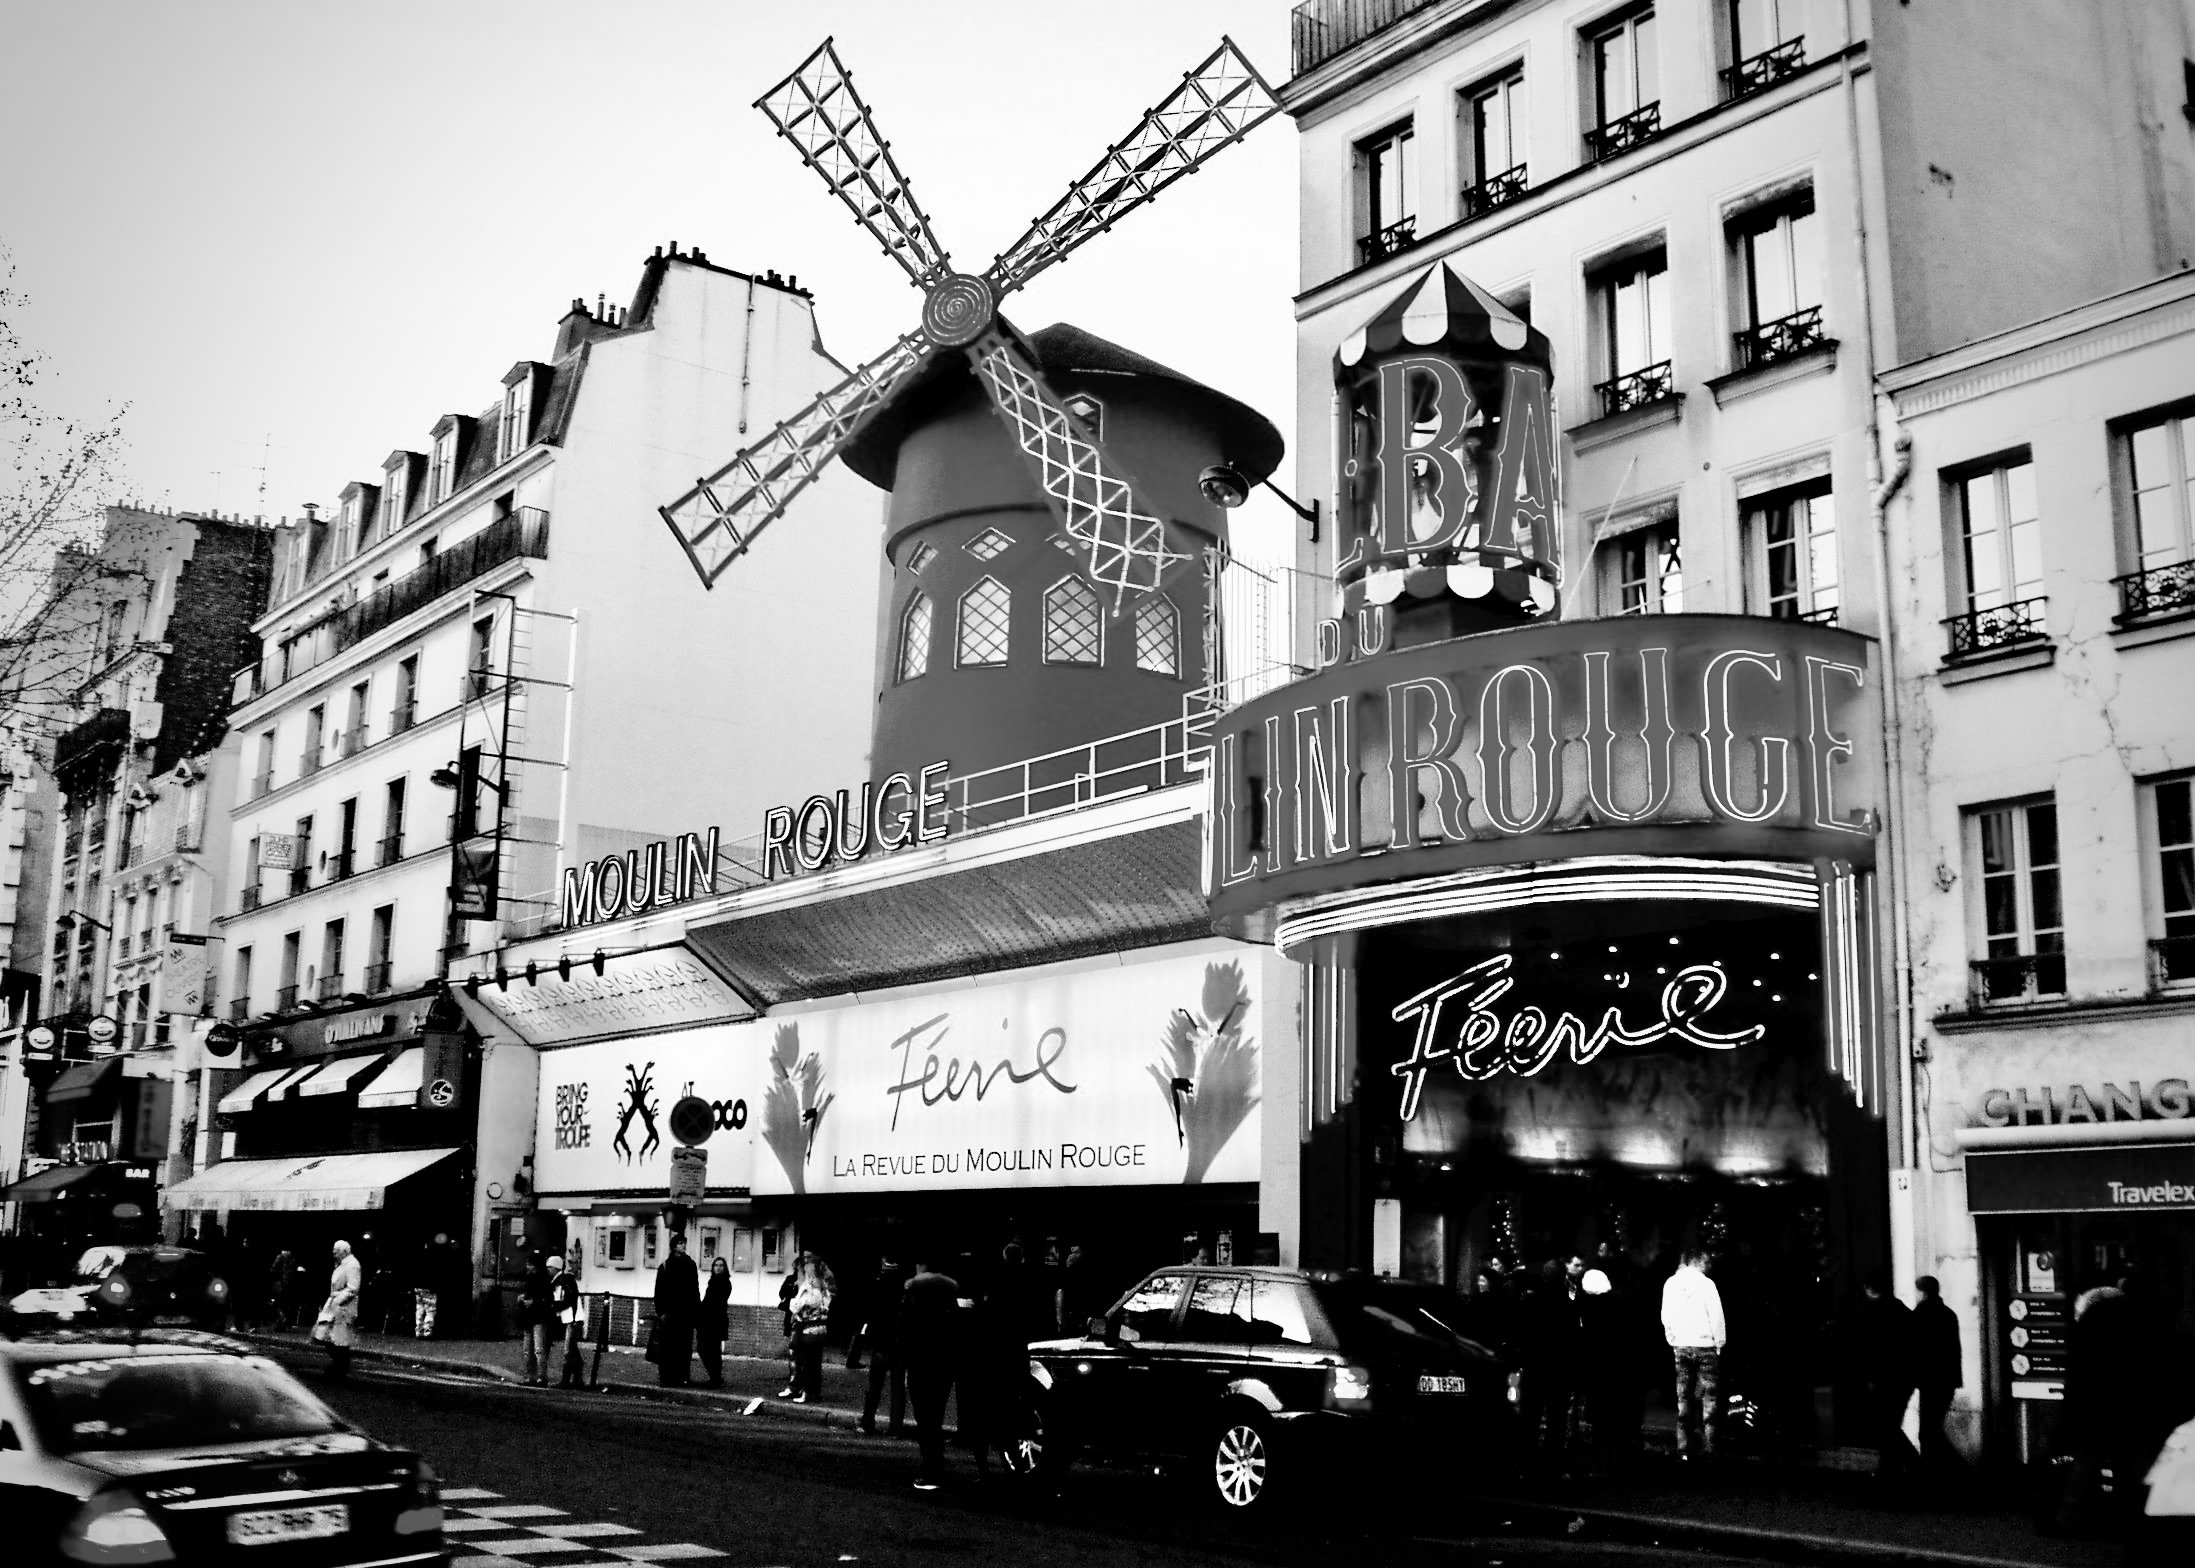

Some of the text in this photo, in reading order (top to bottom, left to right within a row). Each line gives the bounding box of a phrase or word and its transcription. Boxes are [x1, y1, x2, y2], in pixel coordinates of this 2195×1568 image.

[1318, 605, 1384, 667] DU
[1386, 647, 1872, 850] ROUGE
[562, 760, 950, 929] MOULIN ROUGE
[1391, 953, 1765, 1121] Féerie
[887, 1012, 1078, 1132] Féerie
[556, 1082, 588, 1106] BRING
[711, 1098, 748, 1131] OCO
[1980, 1078, 2191, 1128] CHANG
[555, 1124, 591, 1150] TROUPE
[556, 1104, 583, 1129] YOUR
[833, 1155, 857, 1177] LA
[862, 1153, 926, 1176] REVUE
[966, 1148, 1052, 1172] MOULIN
[1060, 1143, 1146, 1169] ROUGE
[2107, 1180, 2195, 1204] Travelex
